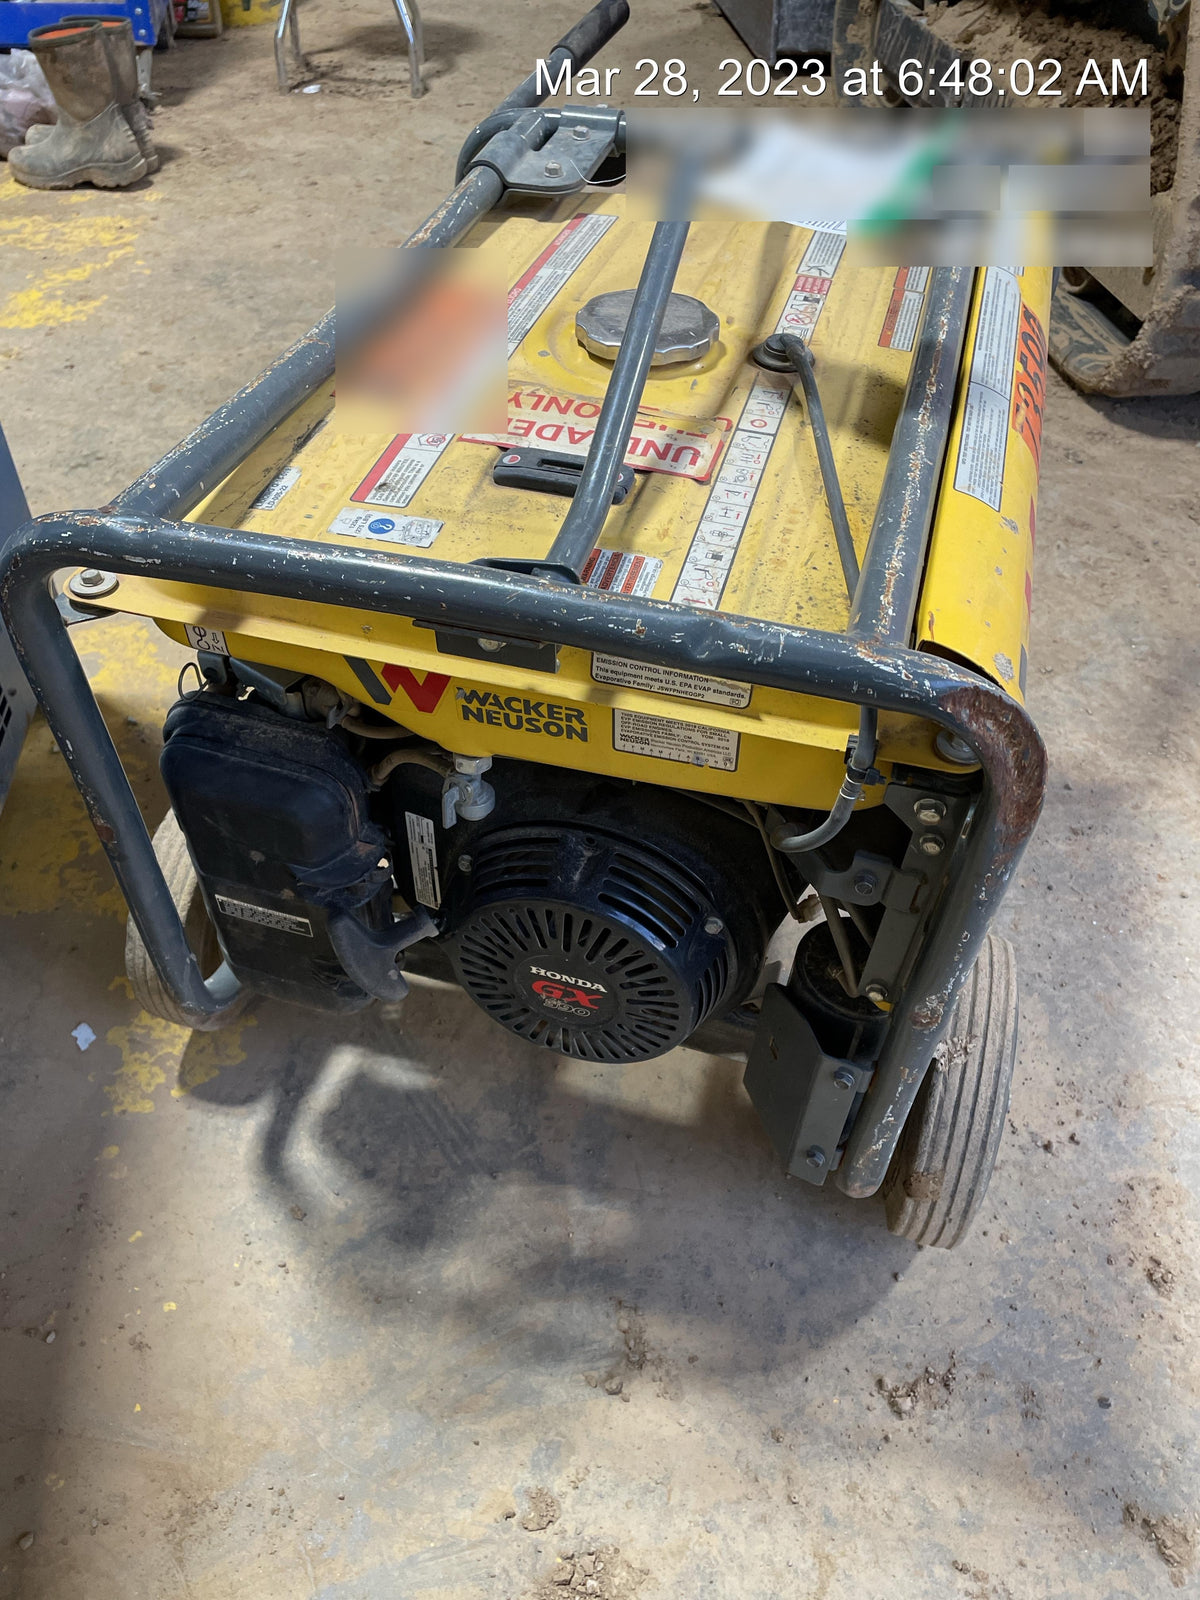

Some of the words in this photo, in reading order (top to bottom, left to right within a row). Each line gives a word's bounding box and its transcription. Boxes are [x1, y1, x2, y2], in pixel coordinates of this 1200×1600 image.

[595, 673, 631, 685] Evaporative
[632, 680, 655, 690] Family:
[596, 657, 627, 668] EMISSION
[629, 663, 661, 674] CONTROL
[663, 669, 709, 683] INFORMATION
[610, 669, 642, 680] equipment
[644, 675, 663, 683] meets
[694, 684, 711, 692] EVAP
[712, 688, 745, 699] standards.
[456, 687, 587, 726] WACKER
[462, 704, 588, 743] NEUSON
[620, 733, 649, 742] WACKER
[619, 737, 649, 746] NEUSON
[529, 965, 608, 993] HONDA
[531, 980, 603, 1010] GX
